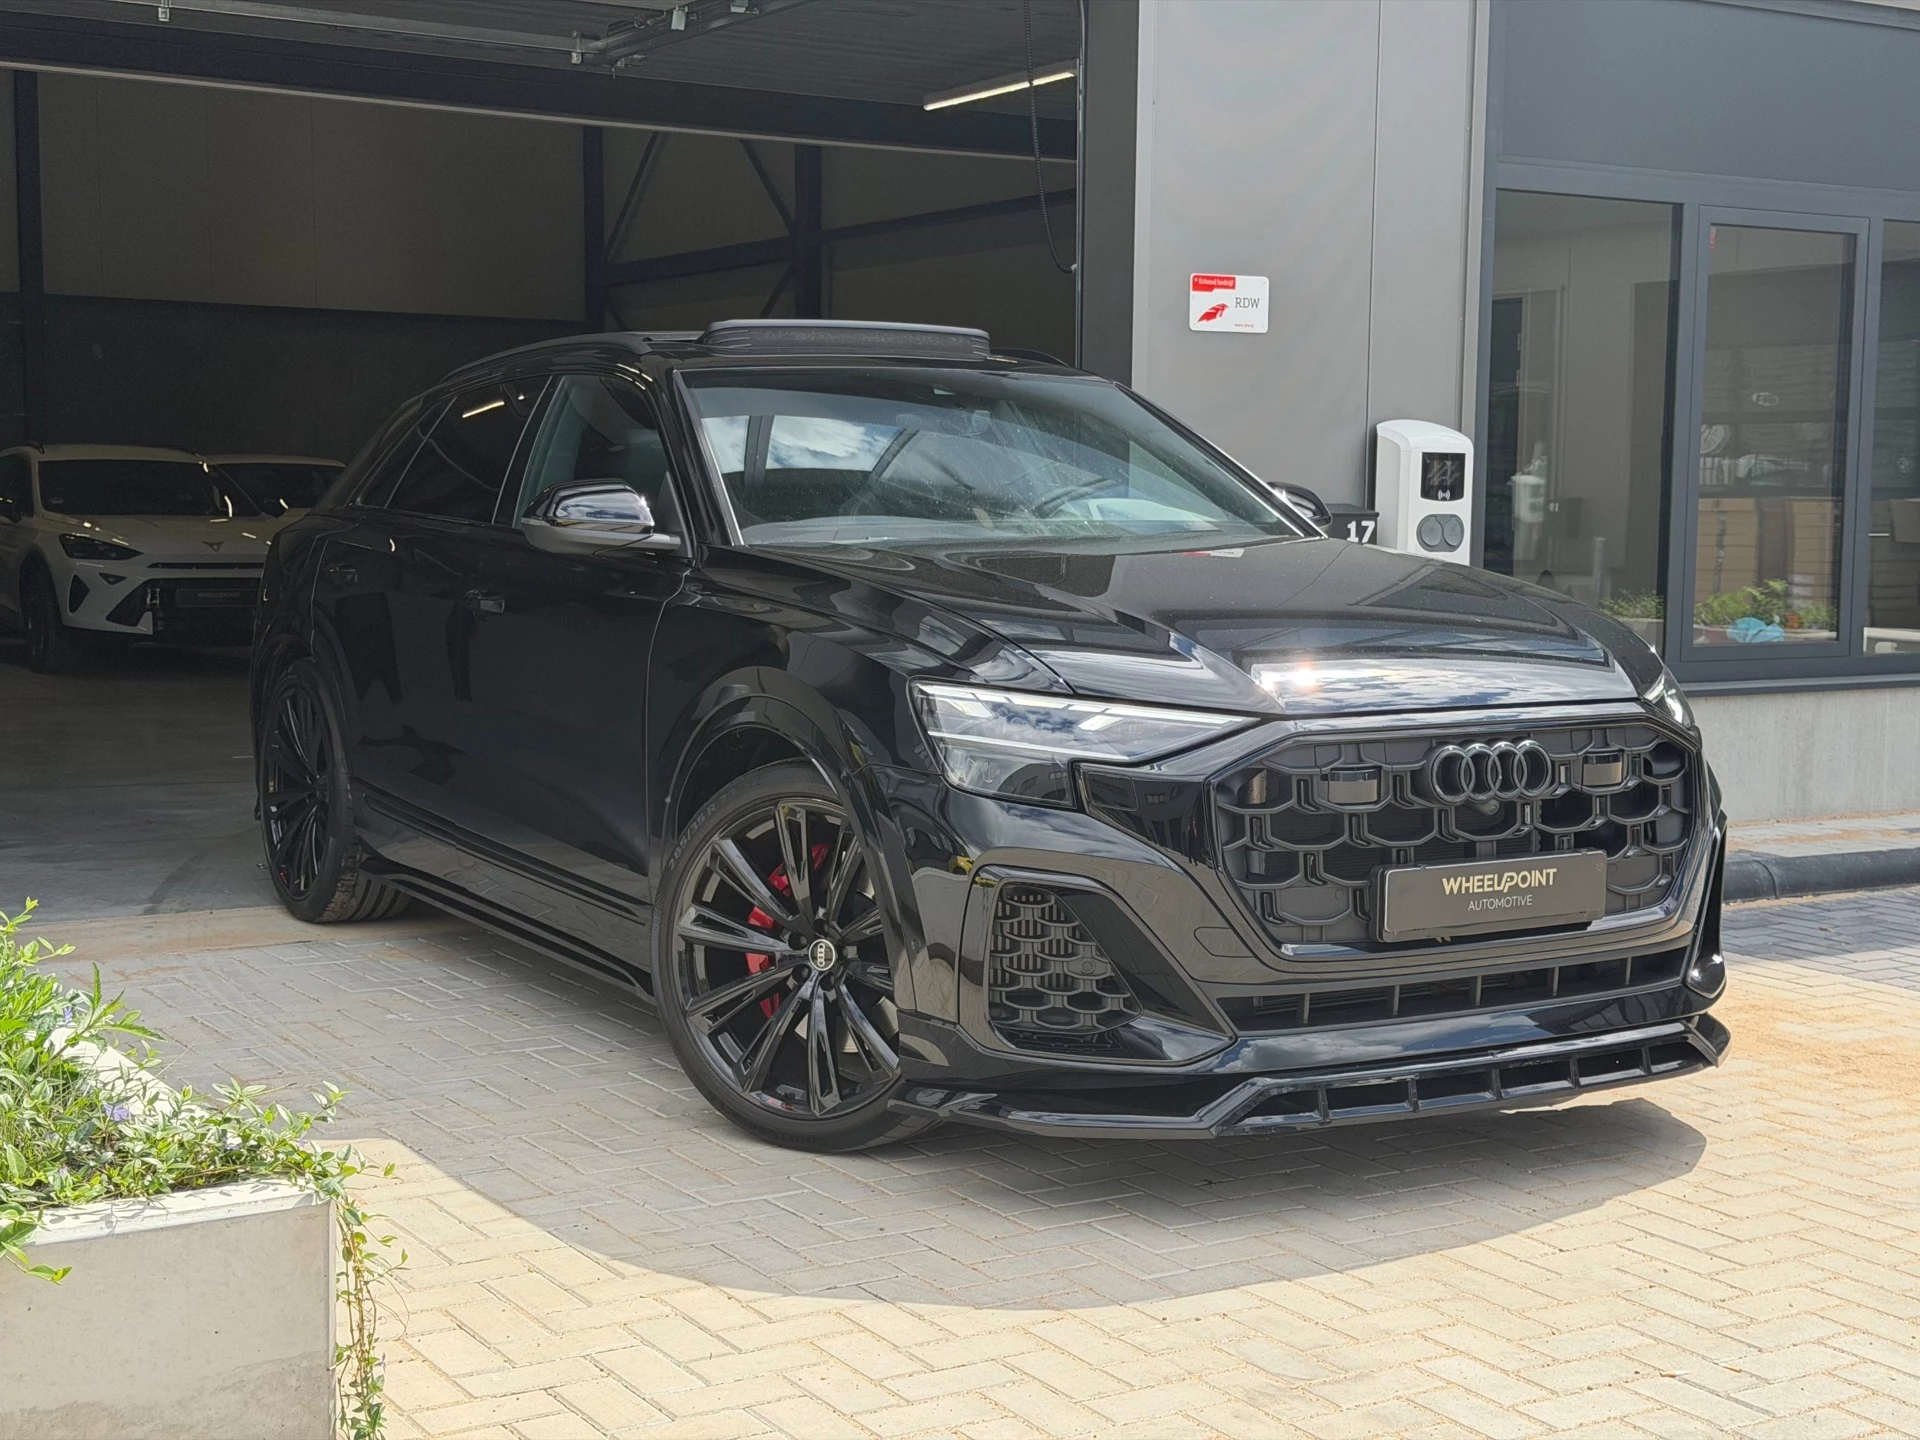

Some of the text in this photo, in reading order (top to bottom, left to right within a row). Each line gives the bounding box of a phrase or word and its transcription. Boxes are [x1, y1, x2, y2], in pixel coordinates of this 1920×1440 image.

[1235, 297, 1260, 308] RDW
[1346, 520, 1375, 543] 17
[1441, 868, 1557, 895] WHEELPOINT
[1467, 894, 1533, 911] AUTOMOTIVE
